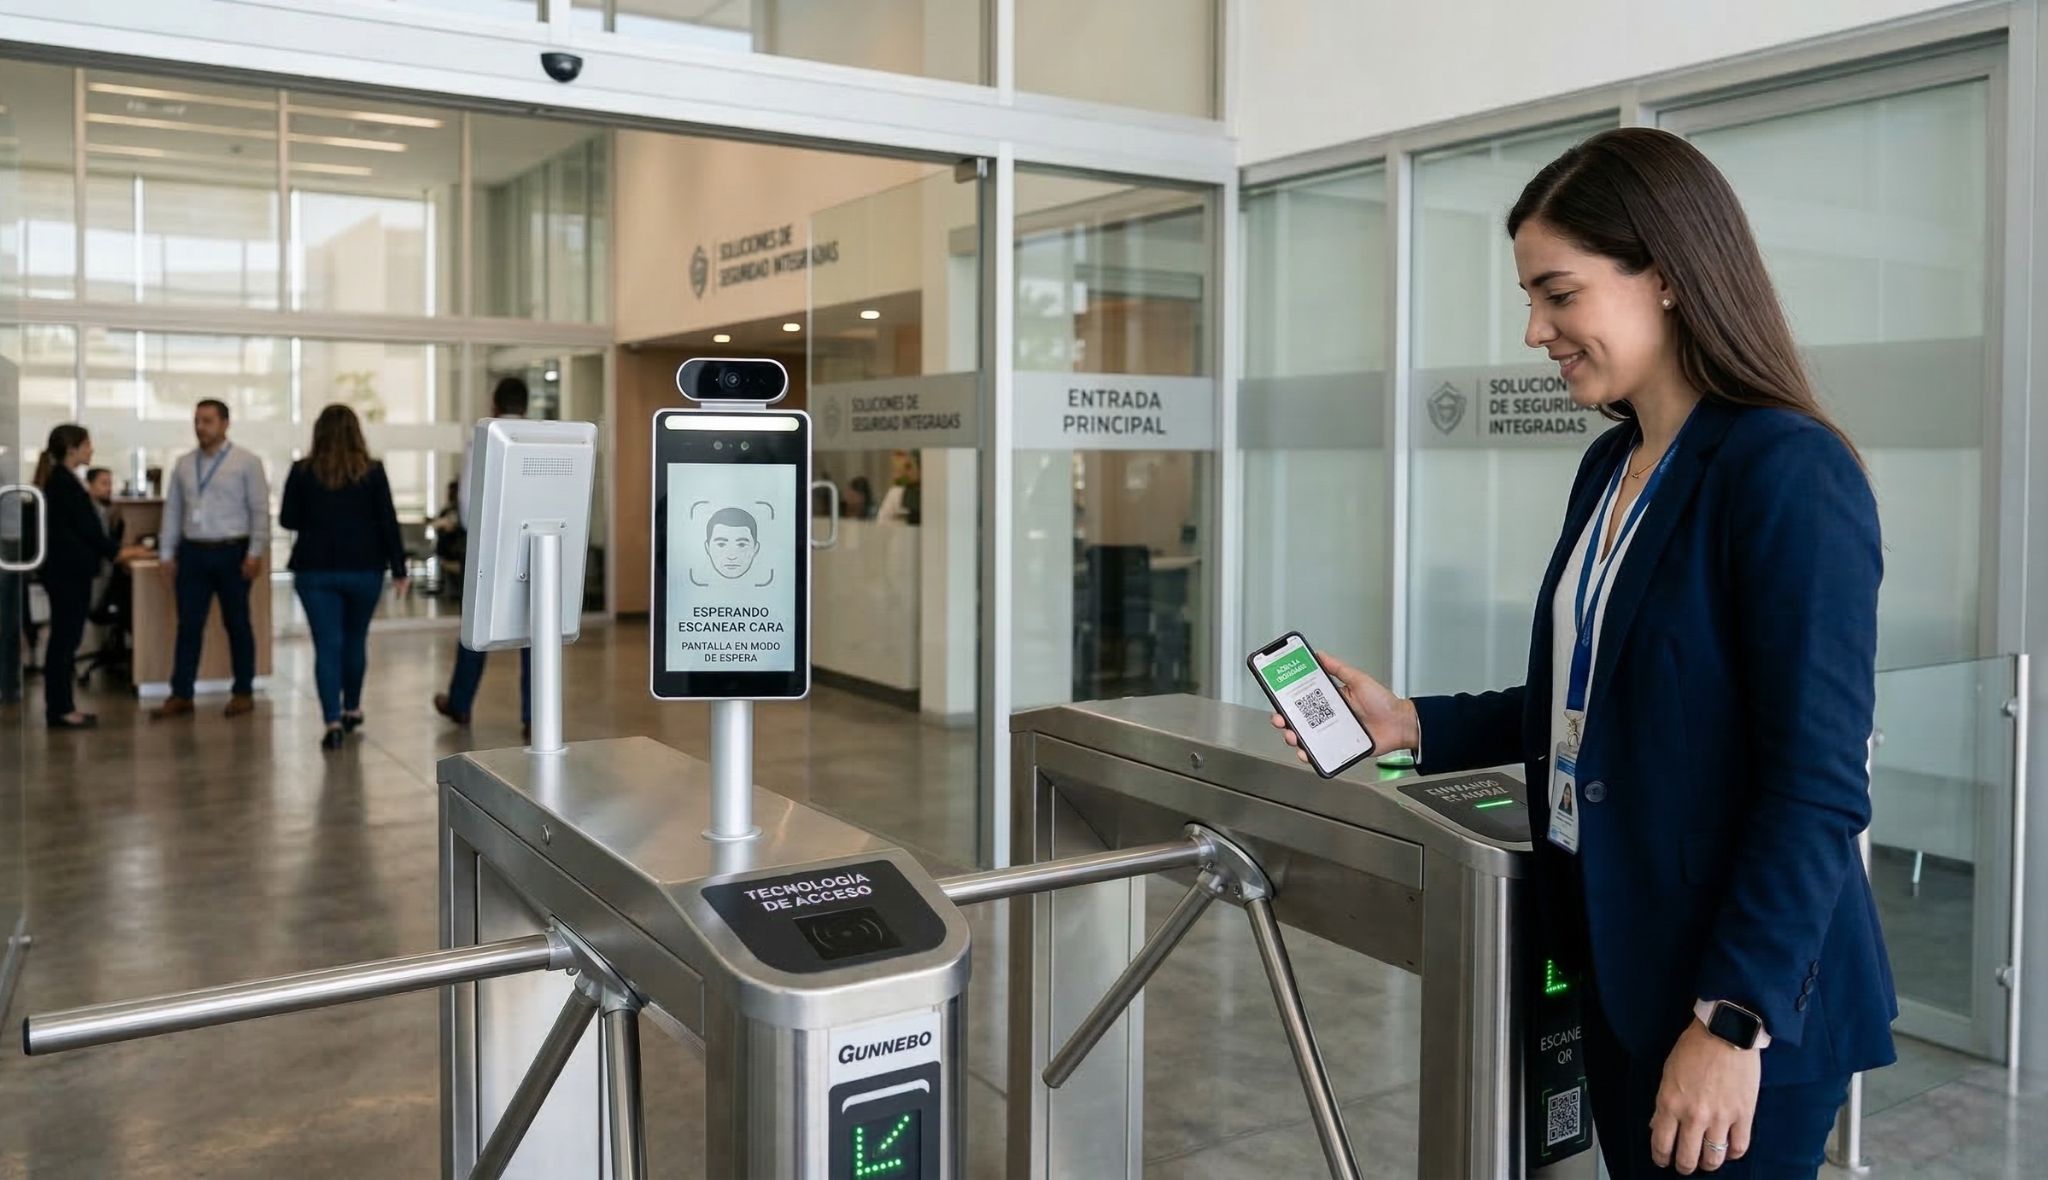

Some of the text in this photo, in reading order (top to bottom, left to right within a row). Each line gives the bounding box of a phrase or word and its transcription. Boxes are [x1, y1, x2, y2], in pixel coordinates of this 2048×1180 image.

[1490, 376, 1568, 395] SOLUCION
[1068, 389, 1162, 409] ENTRADA
[1490, 398, 1599, 414] DE SEGURID
[1063, 414, 1167, 435] PRINCIPAL
[1489, 418, 1587, 435] INTEGRADAS
[693, 606, 769, 618] ESPERANDO
[678, 622, 784, 632] ESCANEAR CARA
[681, 642, 781, 651] PANTALLA EN MODO
[704, 653, 758, 662] DE ESPERA
[761, 885, 872, 912] DE ACCESO
[1540, 1026, 1582, 1051] ESCANE
[838, 1031, 932, 1064] GUNNEBO
[1557, 1048, 1573, 1064] QR
